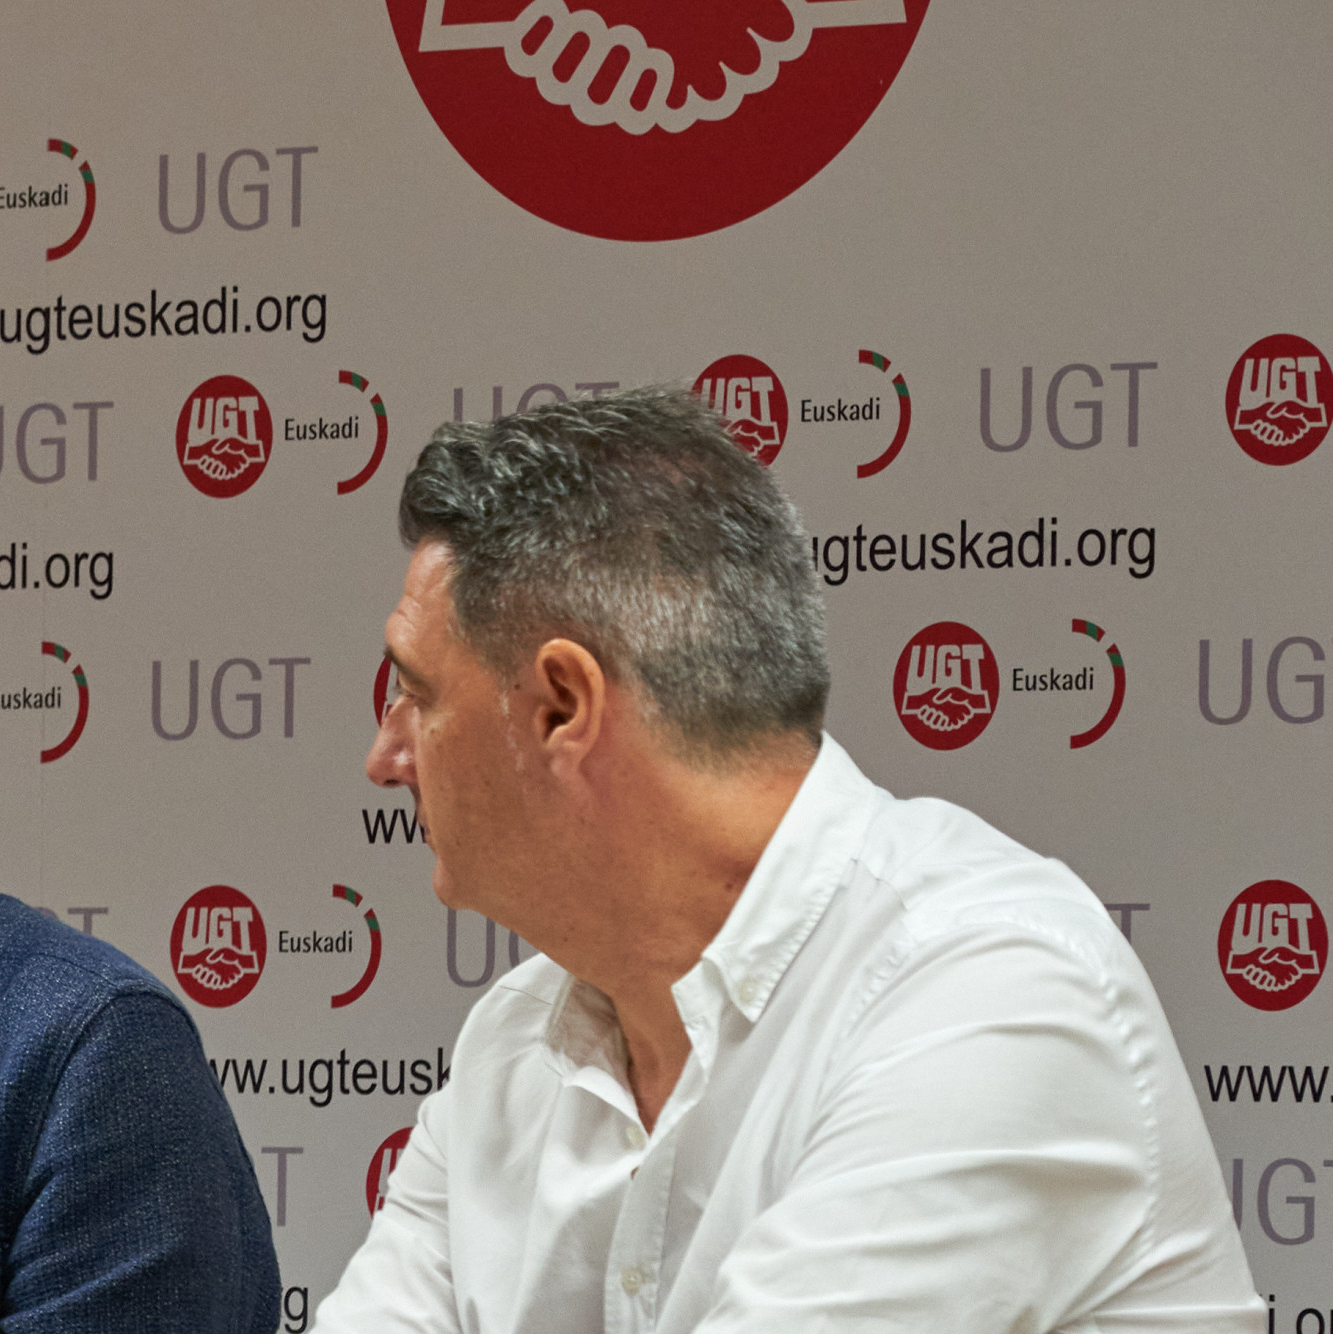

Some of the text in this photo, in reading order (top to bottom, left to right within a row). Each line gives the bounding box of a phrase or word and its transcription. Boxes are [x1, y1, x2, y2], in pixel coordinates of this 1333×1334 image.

[157, 145, 319, 235] UGT
[978, 361, 1159, 453] UGT
[1242, 356, 1323, 411] UGT
[190, 395, 360, 443] UGT Euskadi
[799, 397, 881, 424] Euskadi
[907, 643, 1095, 692] UGT Euskadi
[1198, 636, 1333, 727] UG
[150, 657, 311, 742] UGT
[181, 905, 354, 957] UGT Euskadi
[1232, 902, 1315, 952] UGT
